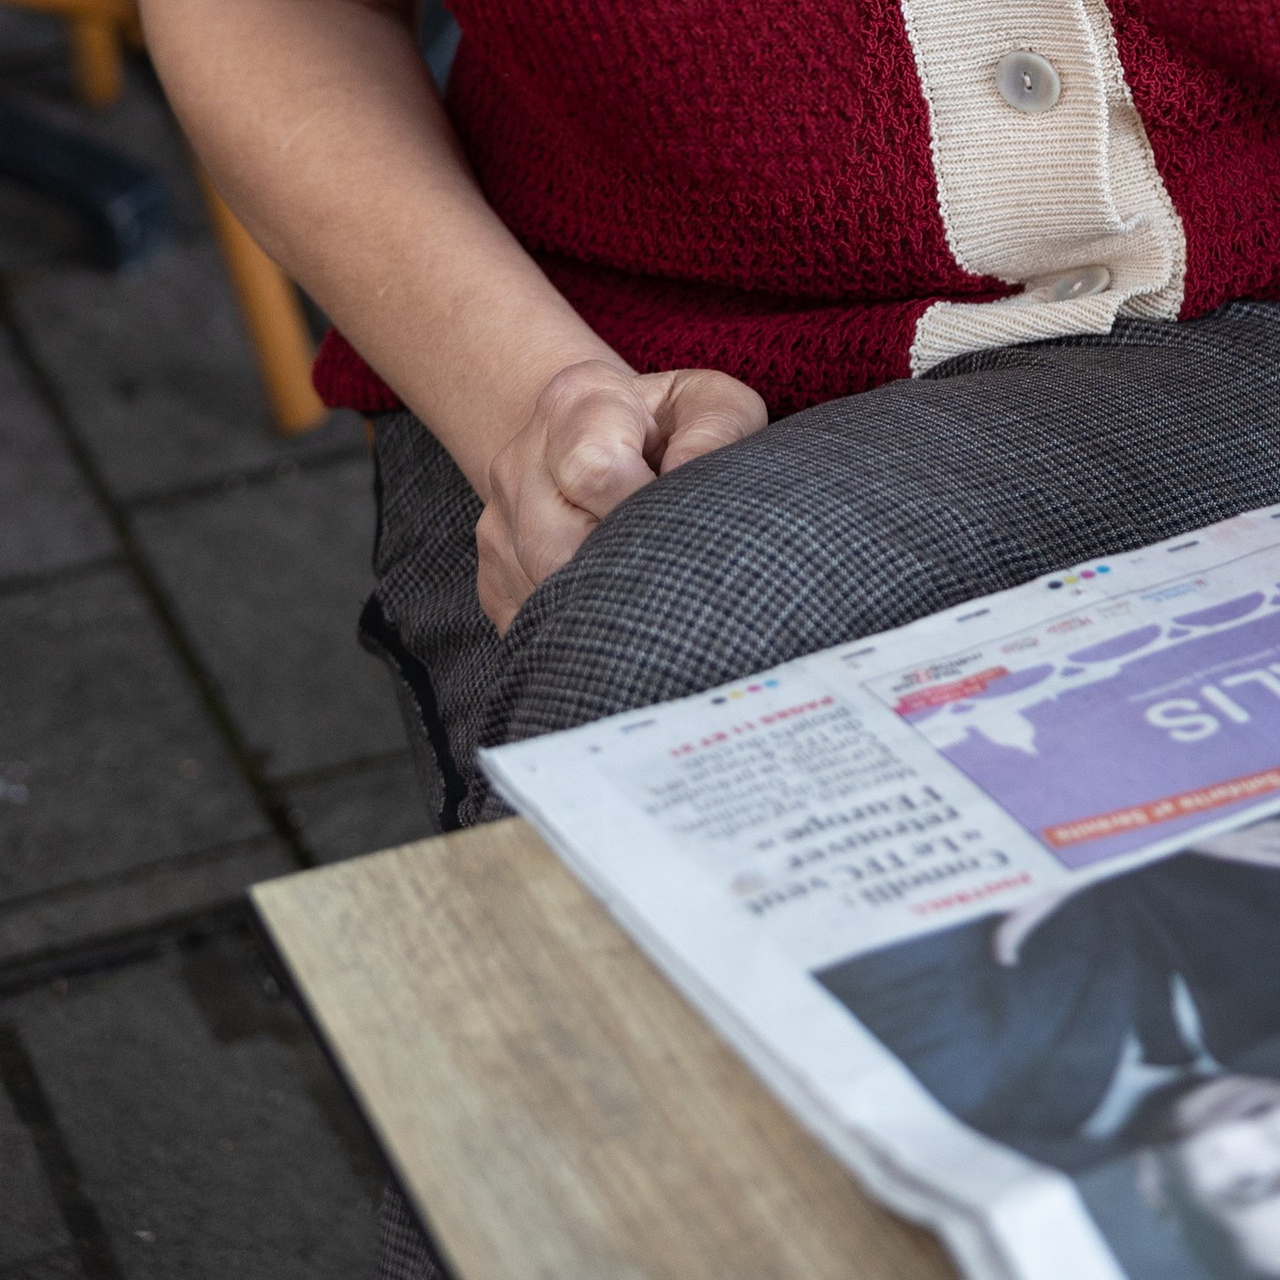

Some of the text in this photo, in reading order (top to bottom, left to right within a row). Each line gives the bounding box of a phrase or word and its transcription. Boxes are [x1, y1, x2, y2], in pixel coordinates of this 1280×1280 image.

[757, 694, 837, 726] PAGES
[773, 782, 944, 847] l'Europe
[782, 805, 962, 872] retrouver
[908, 834, 963, 864] Le
[838, 848, 910, 885] TFC
[857, 847, 1014, 907] Comolli
[739, 874, 833, 917] veut
[908, 869, 1035, 918] FOOTBALL
